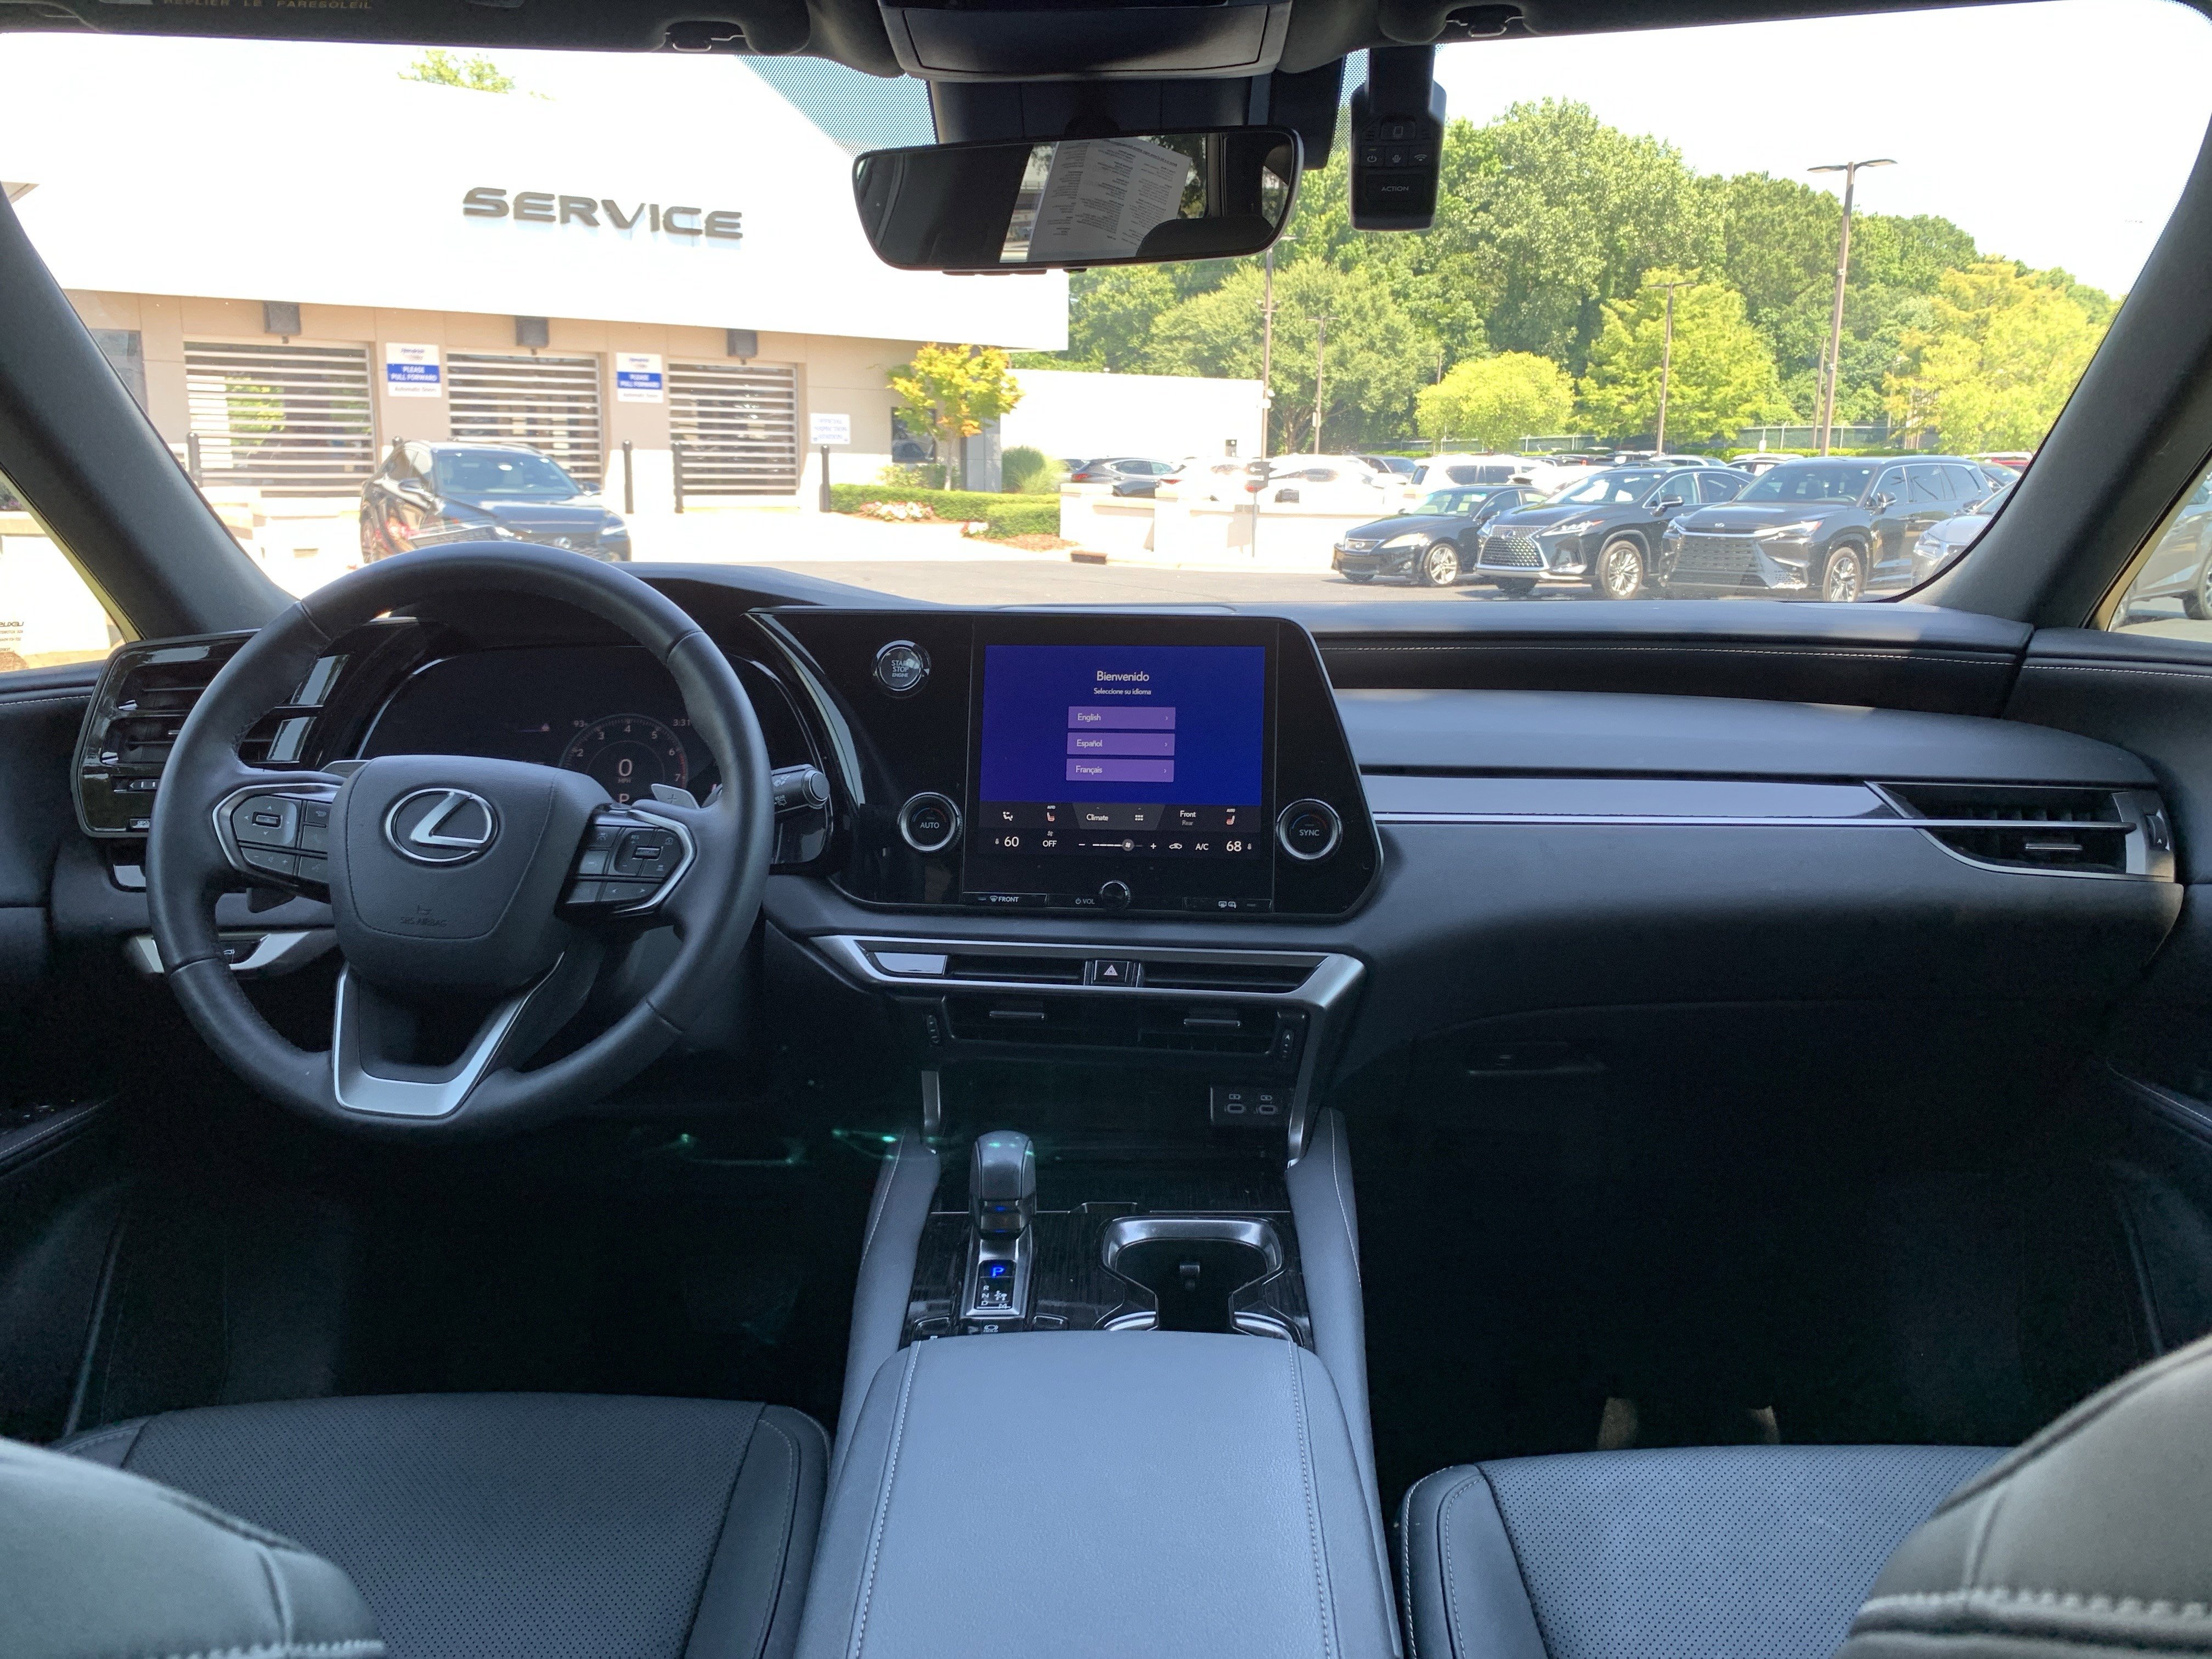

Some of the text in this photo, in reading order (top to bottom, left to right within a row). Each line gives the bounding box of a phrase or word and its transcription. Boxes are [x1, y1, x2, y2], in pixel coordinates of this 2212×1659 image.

[277, 0, 373, 9] PARESOLEIL
[462, 187, 744, 239] SERVICE
[402, 365, 425, 374] PLEASE
[1096, 670, 1150, 682] Bienvenido
[1077, 713, 1101, 723] English
[1076, 739, 1103, 748] Español
[577, 748, 584, 757] 2
[619, 759, 633, 776] 0
[1075, 765, 1103, 775] Français
[619, 794, 630, 804] P
[1086, 814, 1109, 822] Climate
[1180, 810, 1196, 818] Front
[1299, 828, 1319, 838] SYNC
[1004, 836, 1019, 848] 60
[1195, 843, 1209, 851] A/C
[1226, 841, 1242, 851] 68
[992, 1267, 1004, 1277] P
